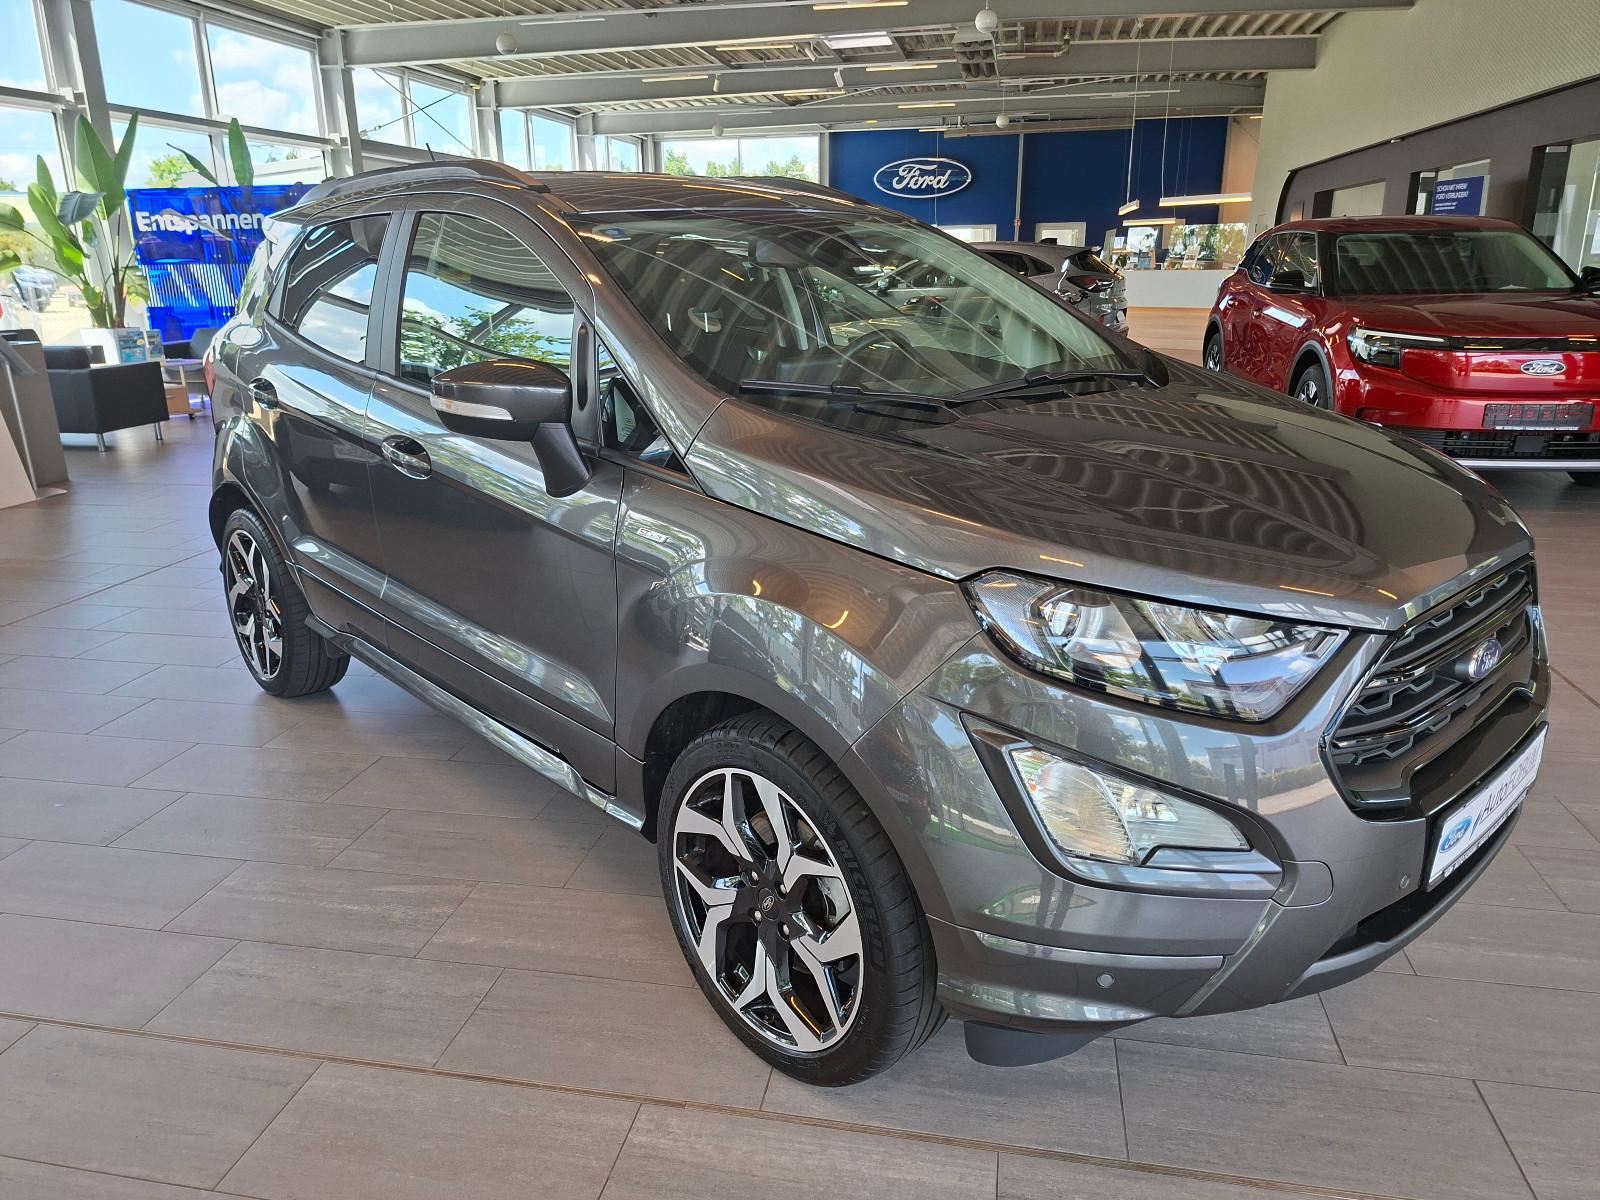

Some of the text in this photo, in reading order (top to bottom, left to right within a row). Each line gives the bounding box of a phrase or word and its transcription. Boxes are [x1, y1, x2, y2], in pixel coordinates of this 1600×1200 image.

[892, 163, 952, 190] Ford
[135, 210, 266, 235] Entspannen
[1529, 361, 1558, 373] Ford
